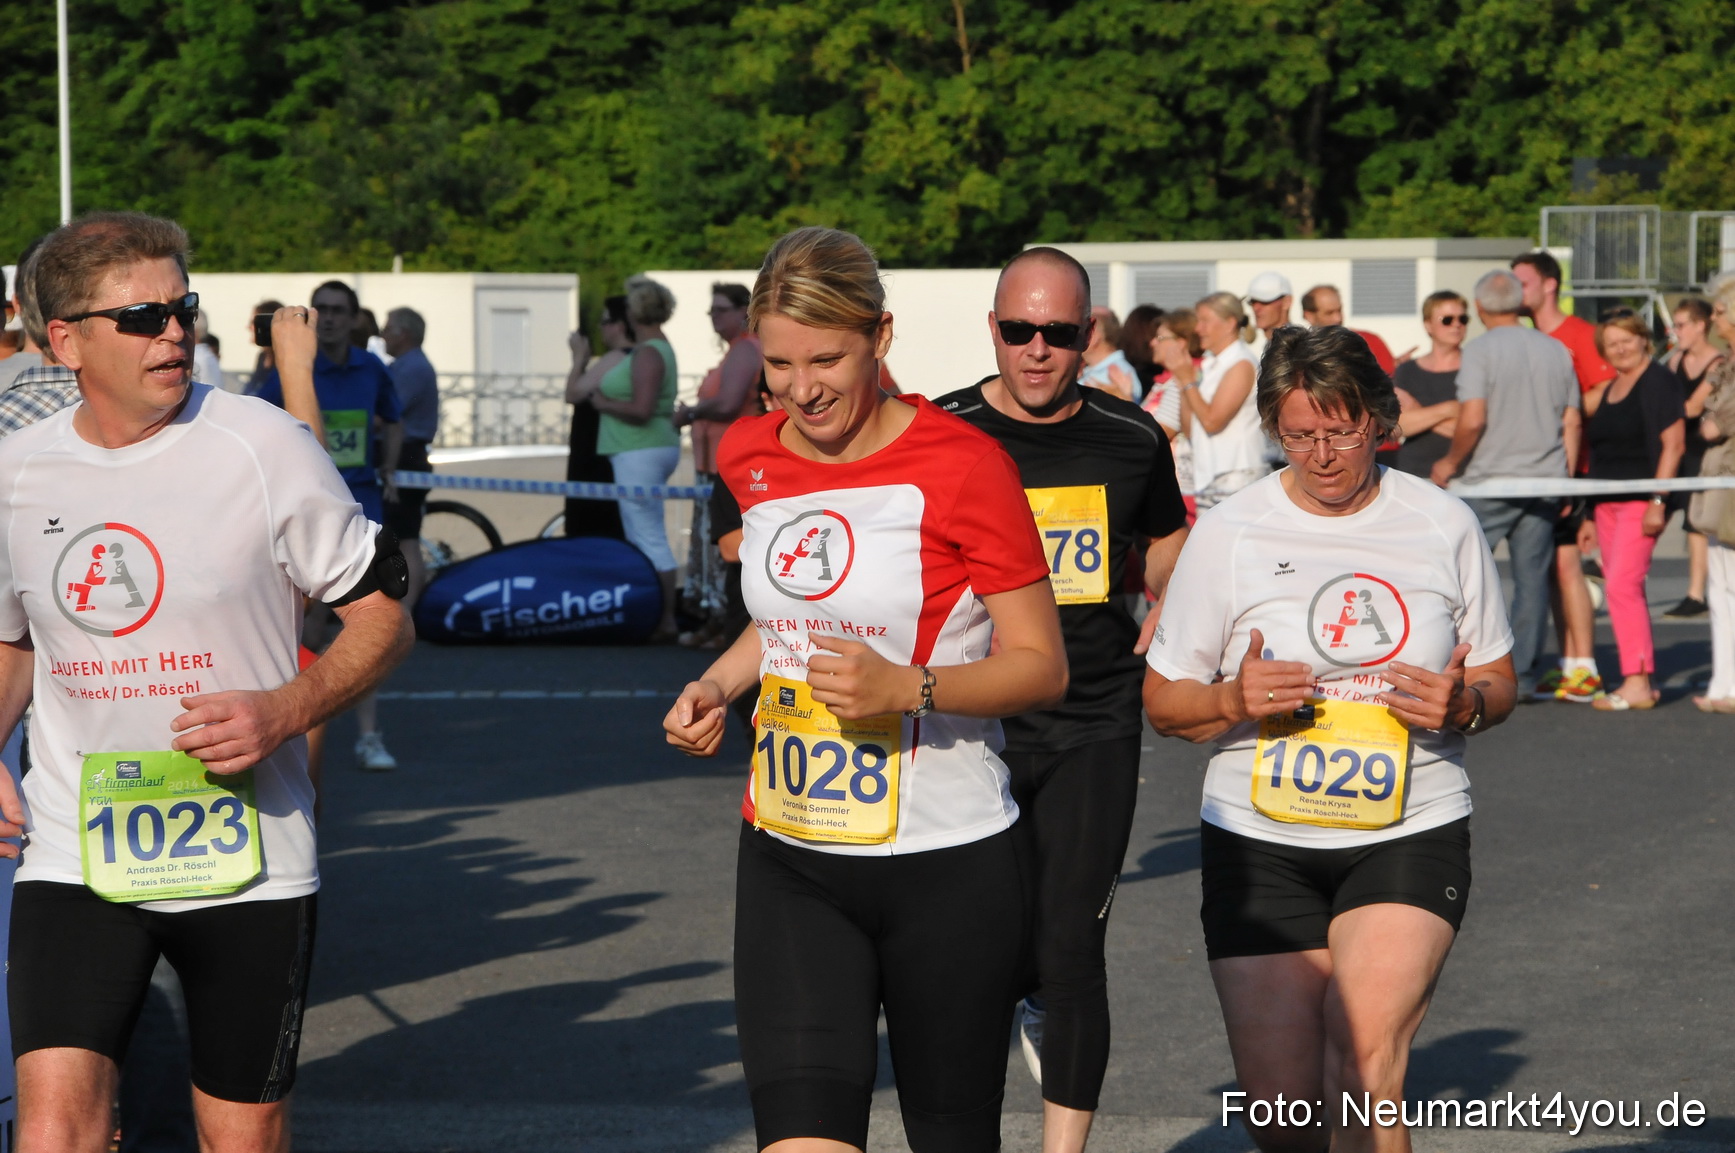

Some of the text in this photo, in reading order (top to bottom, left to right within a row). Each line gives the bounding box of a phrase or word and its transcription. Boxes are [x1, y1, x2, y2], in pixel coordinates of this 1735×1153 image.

[330, 430, 357, 452] 34
[44, 526, 64, 535] erima
[1045, 528, 1102, 574] 78
[1274, 568, 1295, 576] erima
[481, 577, 631, 632] Fischer
[755, 618, 887, 637] AUFEN MIT HERZ
[767, 638, 782, 648] Dr.
[49, 651, 214, 676] LAUFEN MIT HERZ
[122, 687, 144, 699] Dr.
[148, 681, 200, 696] Röschl
[1353, 674, 1385, 689] MIT
[1353, 691, 1369, 702] Dr.
[771, 701, 814, 720] firmenlauf
[757, 730, 889, 804] 1028
[1262, 741, 1396, 801] 1029
[105, 776, 165, 789] firmenlauf
[782, 797, 850, 815] Veronika Semmler
[1299, 796, 1352, 809] Renate Krysa
[782, 811, 799, 823] Praxis
[799, 814, 848, 828] Röschl-Heck
[1290, 805, 1312, 814] Praxis
[1313, 808, 1358, 819] Röschl-Heck
[87, 796, 249, 864] 1023
[126, 861, 216, 876] Andreas Dr. Röschl
[131, 873, 213, 887] Praxis Röschl-Heck
